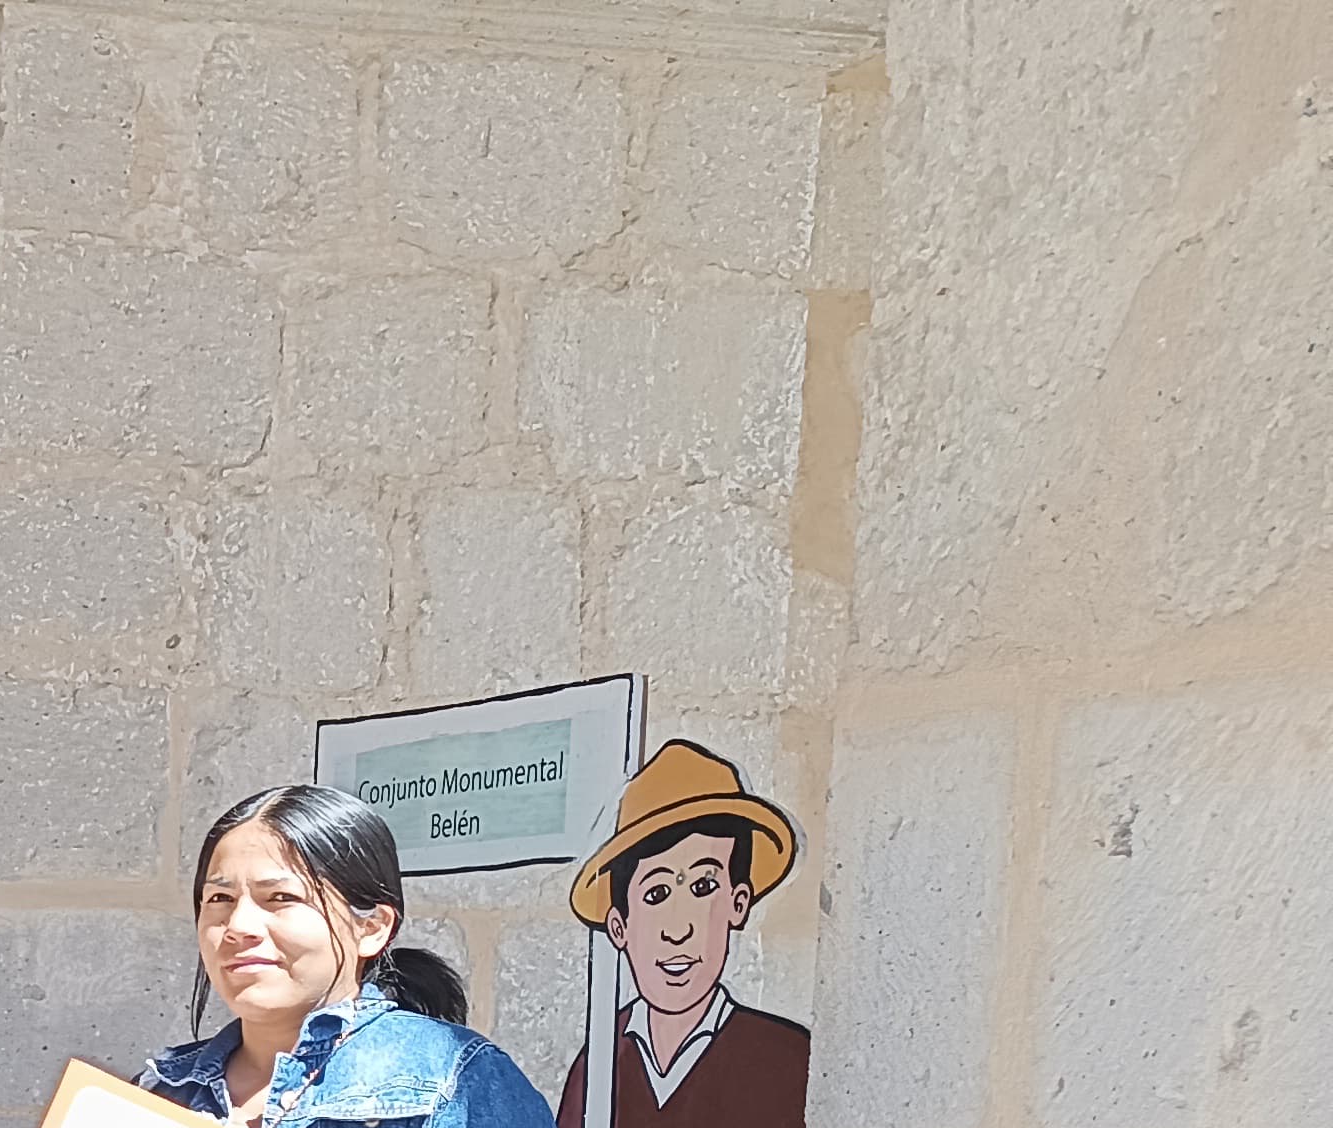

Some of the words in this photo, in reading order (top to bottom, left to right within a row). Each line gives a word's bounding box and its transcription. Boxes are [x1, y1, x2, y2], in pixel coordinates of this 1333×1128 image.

[358, 775, 436, 809] Conjunto
[441, 751, 564, 795] Monumental
[430, 810, 480, 839] Belén
